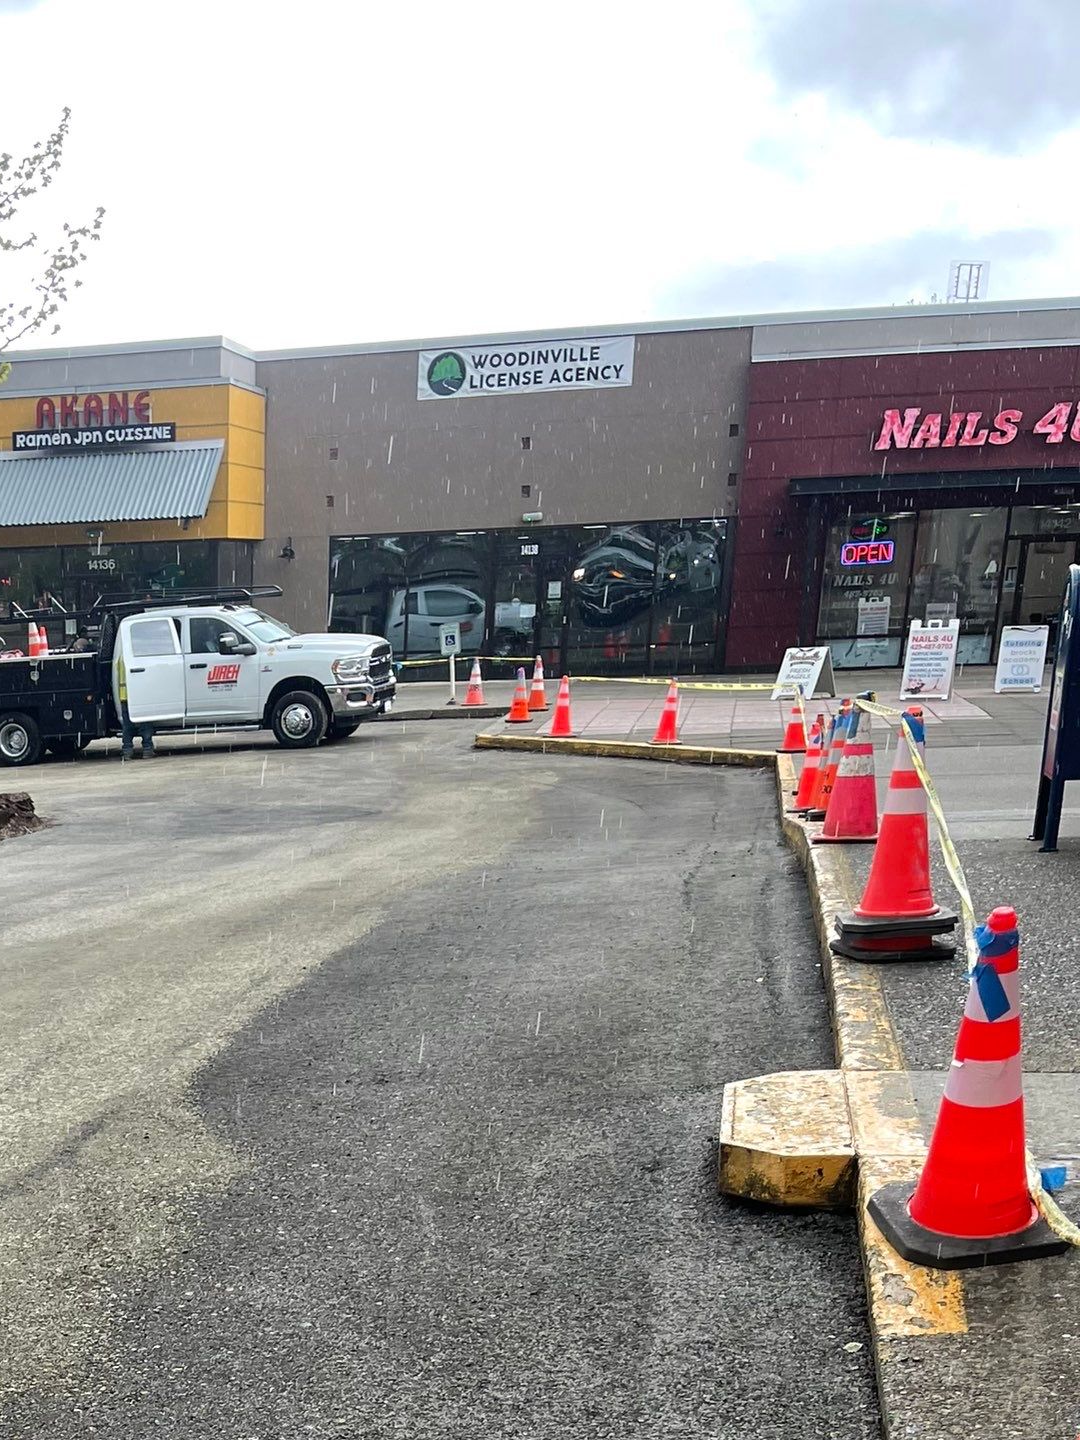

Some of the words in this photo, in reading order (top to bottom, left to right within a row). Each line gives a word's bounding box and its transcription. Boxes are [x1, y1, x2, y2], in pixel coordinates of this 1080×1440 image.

[471, 346, 600, 369] WOODINVILLE
[469, 370, 544, 390] LICENSE
[549, 364, 625, 384] AGENCY
[35, 390, 151, 429] AKANE
[105, 426, 172, 442] CUISINE
[873, 407, 1023, 451] NAILS
[844, 543, 893, 563] OPEN
[87, 558, 116, 571] 14136
[833, 574, 874, 587] NAILS
[879, 573, 898, 586] 4U
[911, 635, 939, 643] NAILS
[941, 634, 954, 643] 4U
